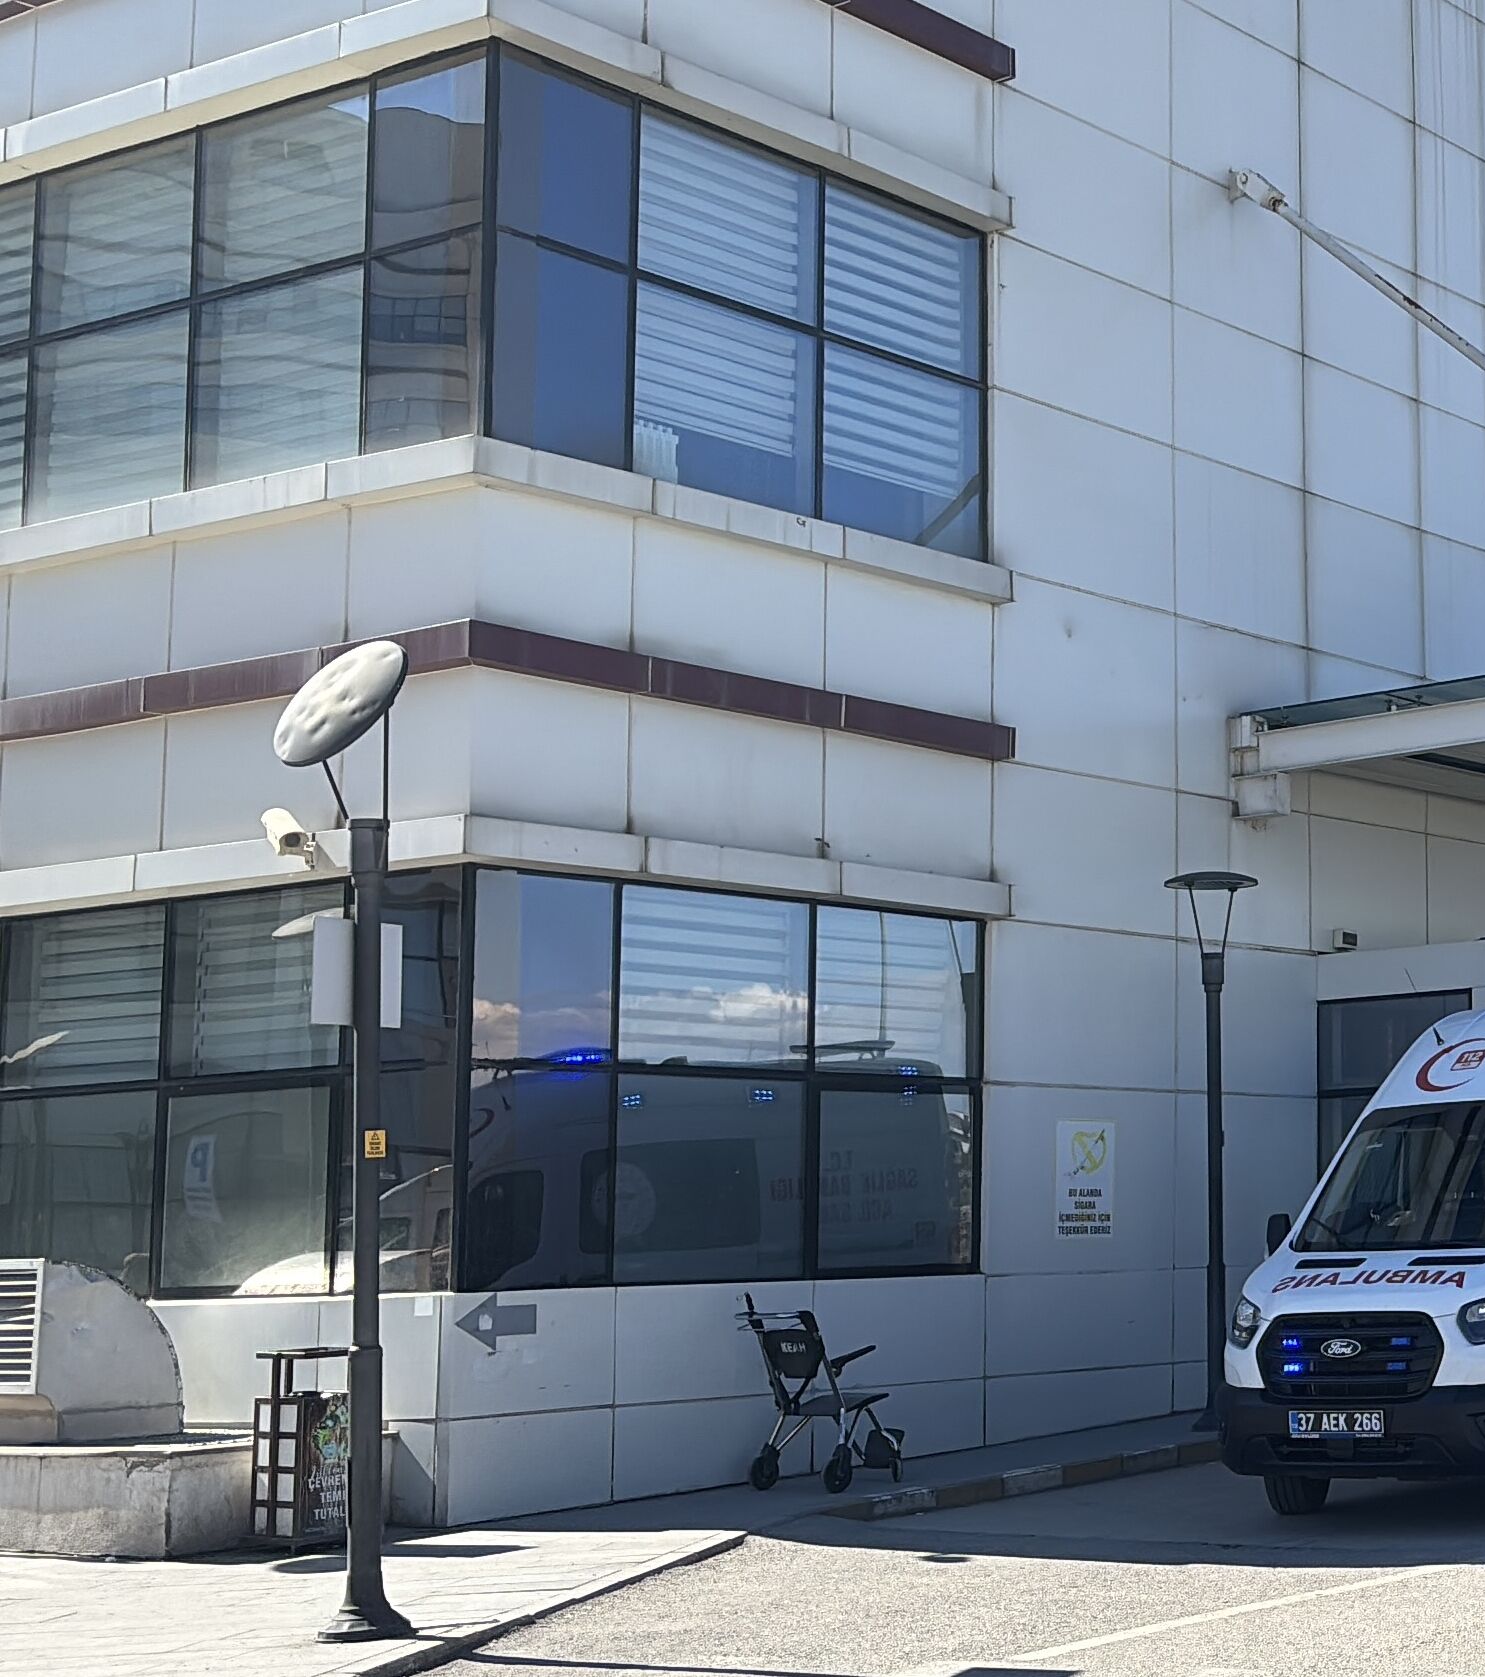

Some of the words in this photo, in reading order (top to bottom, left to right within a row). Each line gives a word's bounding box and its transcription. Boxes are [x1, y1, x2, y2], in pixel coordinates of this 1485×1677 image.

[1461, 1051, 1482, 1063] 112
[1327, 1342, 1353, 1355] Ford
[1297, 1413, 1314, 1431] 37
[1321, 1413, 1348, 1432] AEK
[1353, 1412, 1381, 1431] 266
